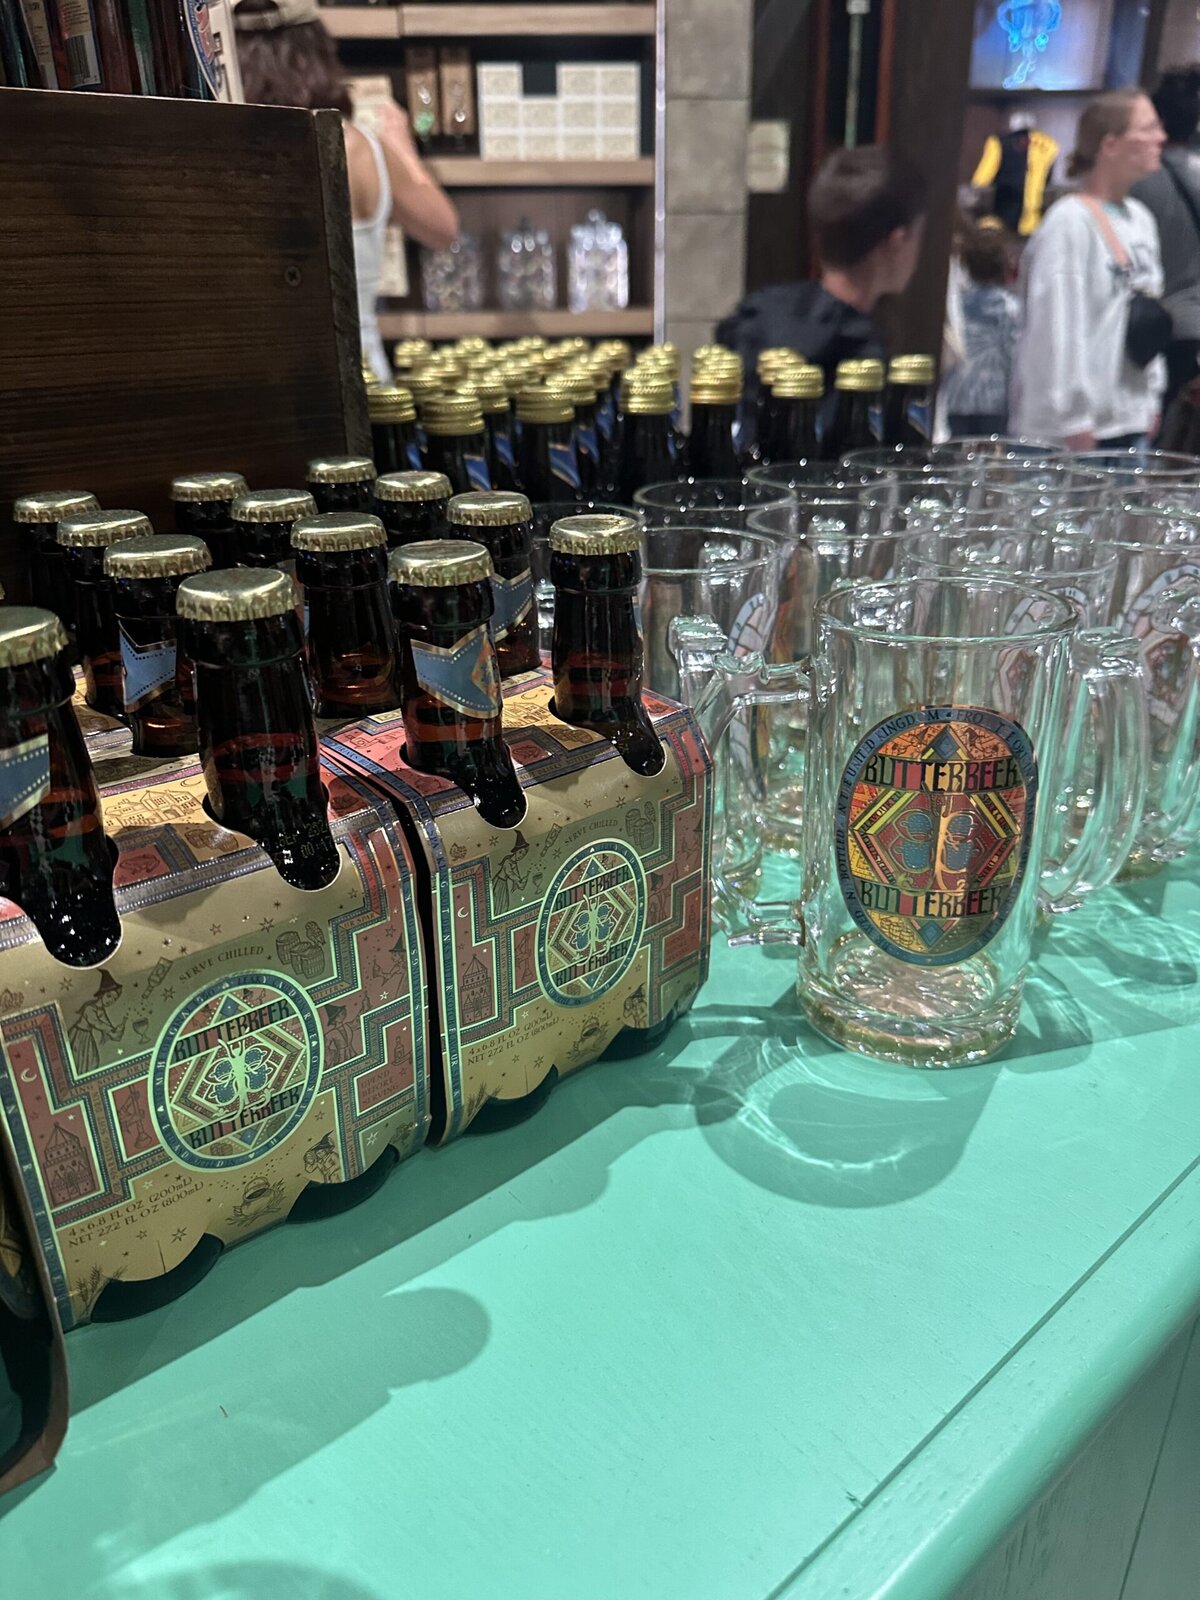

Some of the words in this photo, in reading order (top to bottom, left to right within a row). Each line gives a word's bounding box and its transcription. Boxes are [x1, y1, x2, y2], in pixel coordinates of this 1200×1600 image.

[864, 754, 1019, 793] BUTTERBEER
[588, 819, 618, 831] CHILLED
[835, 830, 849, 880] BOTTLED
[846, 739, 875, 777] UNITD
[556, 868, 628, 912] BUTTERBEER
[861, 881, 1002, 918] BUTTERBEER
[179, 960, 213, 983] SERVE
[218, 946, 264, 964] CHILLED
[557, 941, 629, 987] BUTTERBEER
[174, 998, 291, 1063] BUTTERBEER
[468, 1053, 485, 1066] NET
[506, 1040, 516, 1050] FL
[517, 1031, 529, 1043] OZ
[497, 1034, 506, 1044] FL
[508, 1028, 521, 1039] OZ
[189, 1087, 300, 1150] BUTTERBEER
[68, 1232, 94, 1248] NET
[124, 1213, 138, 1225] FL
[140, 1205, 160, 1219] OZ
[161, 1181, 205, 1208] (800mL)
[69, 1227, 77, 1237] 4
[87, 1216, 106, 1230] 6.8
[110, 1210, 123, 1221] FL
[125, 1200, 145, 1213] OZ
[148, 1175, 193, 1203] (200mL)
